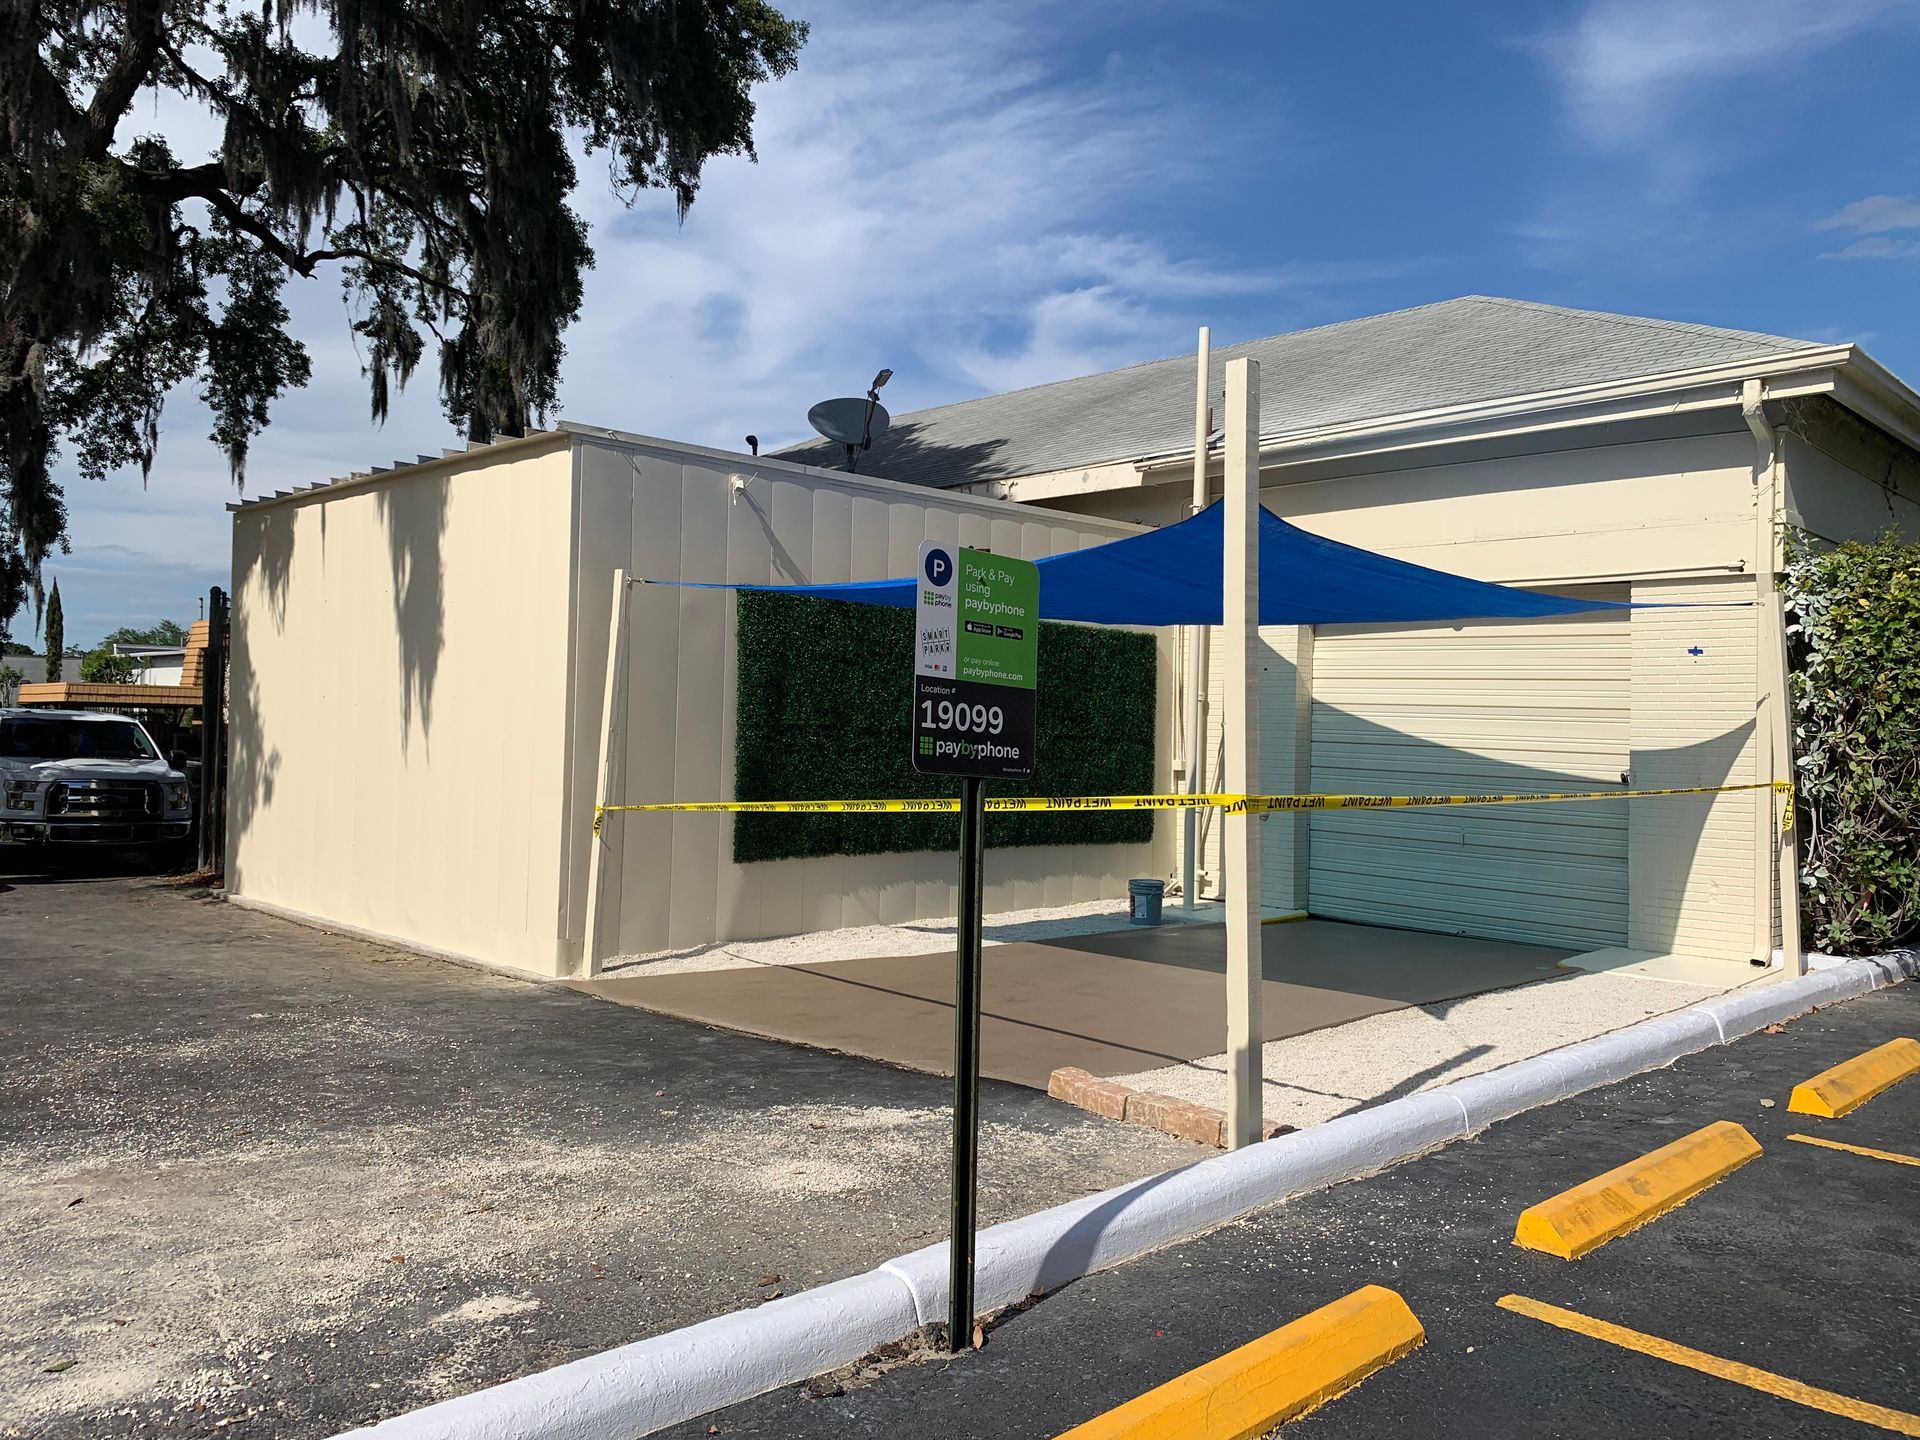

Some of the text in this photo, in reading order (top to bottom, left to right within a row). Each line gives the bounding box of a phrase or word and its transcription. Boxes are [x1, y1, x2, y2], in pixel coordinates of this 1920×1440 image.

[933, 559, 945, 578] P
[966, 564, 1015, 586] Park & Pay
[965, 582, 991, 597] using
[935, 600, 952, 608] phone
[965, 598, 1025, 617] paybyphone
[922, 629, 949, 641] SMART
[970, 657, 982, 666] pay
[963, 667, 1023, 681] paybyphone.com
[921, 683, 951, 695] Location
[921, 700, 1004, 735] 19099
[935, 739, 1020, 760] paybyphone
[901, 800, 953, 811] WET PAINT
[1001, 798, 1027, 809] WET
[1045, 798, 1112, 809] WET PAINT
[1134, 797, 1210, 807] WET PAINT
[1267, 797, 1325, 809] WET PAINT
[1341, 796, 1393, 807] WET PAINT
[1405, 796, 1451, 806] WET PAINT
